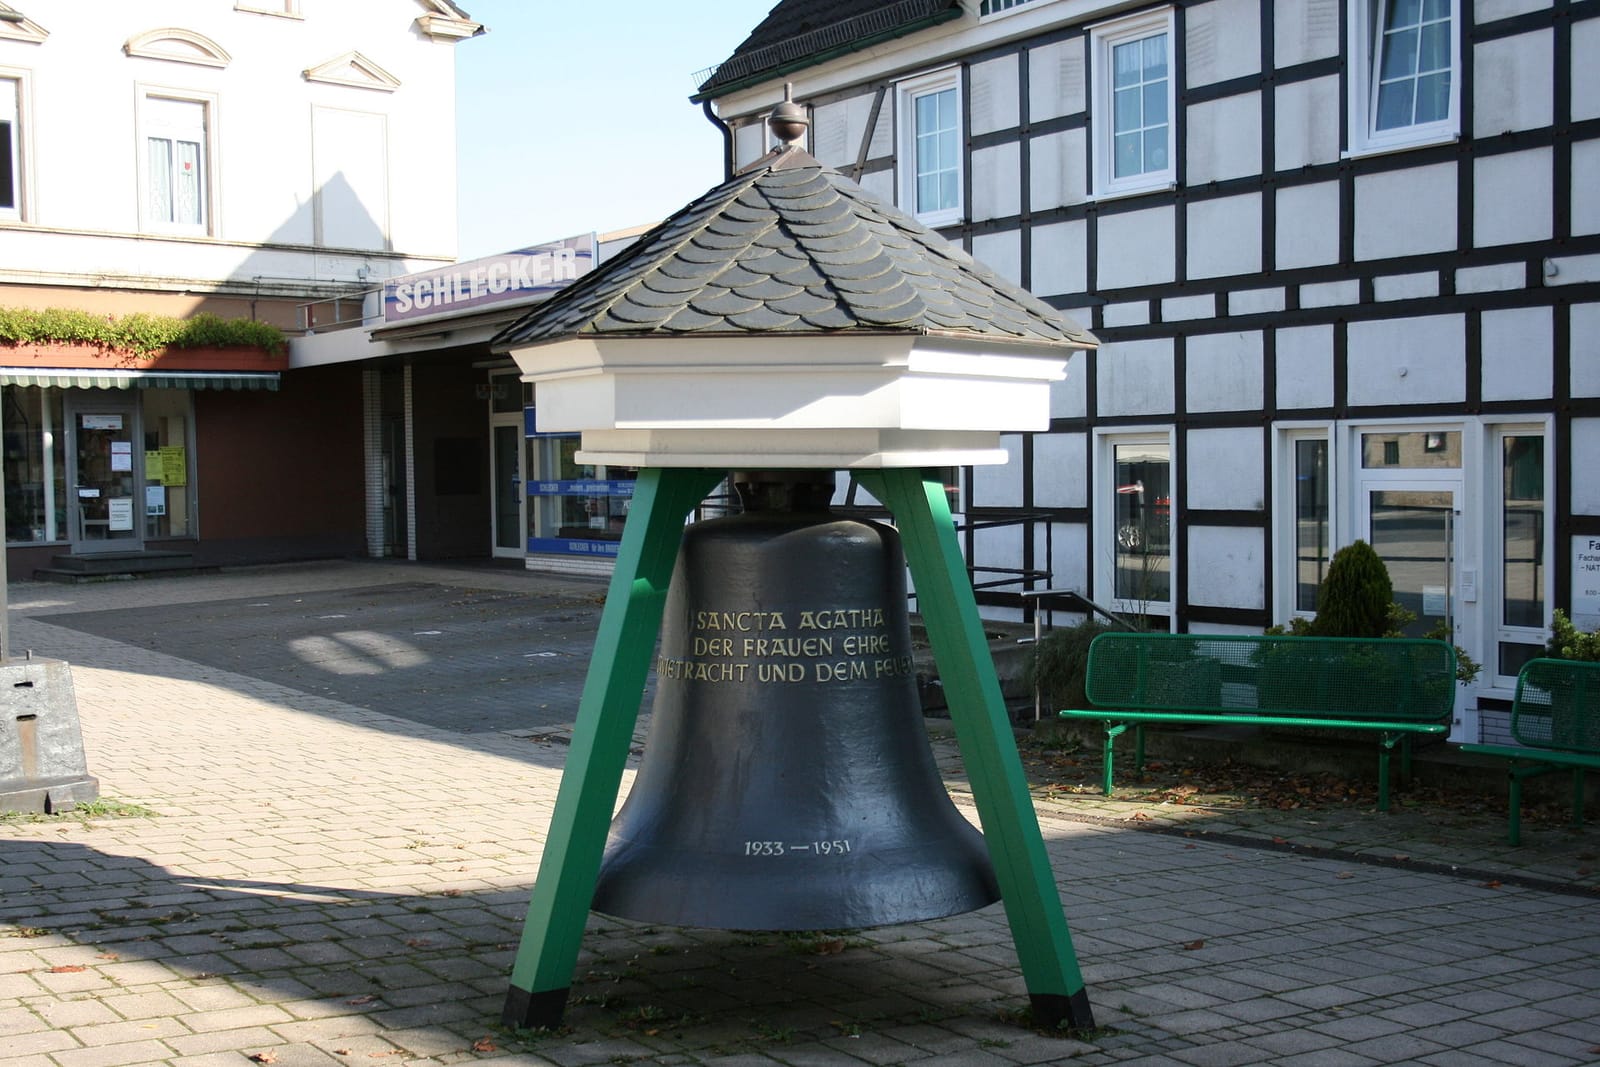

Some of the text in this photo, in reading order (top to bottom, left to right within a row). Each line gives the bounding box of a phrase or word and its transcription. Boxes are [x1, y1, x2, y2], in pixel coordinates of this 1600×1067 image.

[395, 247, 576, 313] SCHLECKER
[697, 608, 885, 631] SANCTA AGATHA
[694, 634, 889, 658] DER FRAUEN EHRE
[758, 663, 804, 682] UND
[815, 661, 868, 682] DEM
[744, 841, 785, 856] 1933
[813, 839, 851, 855] 1951
